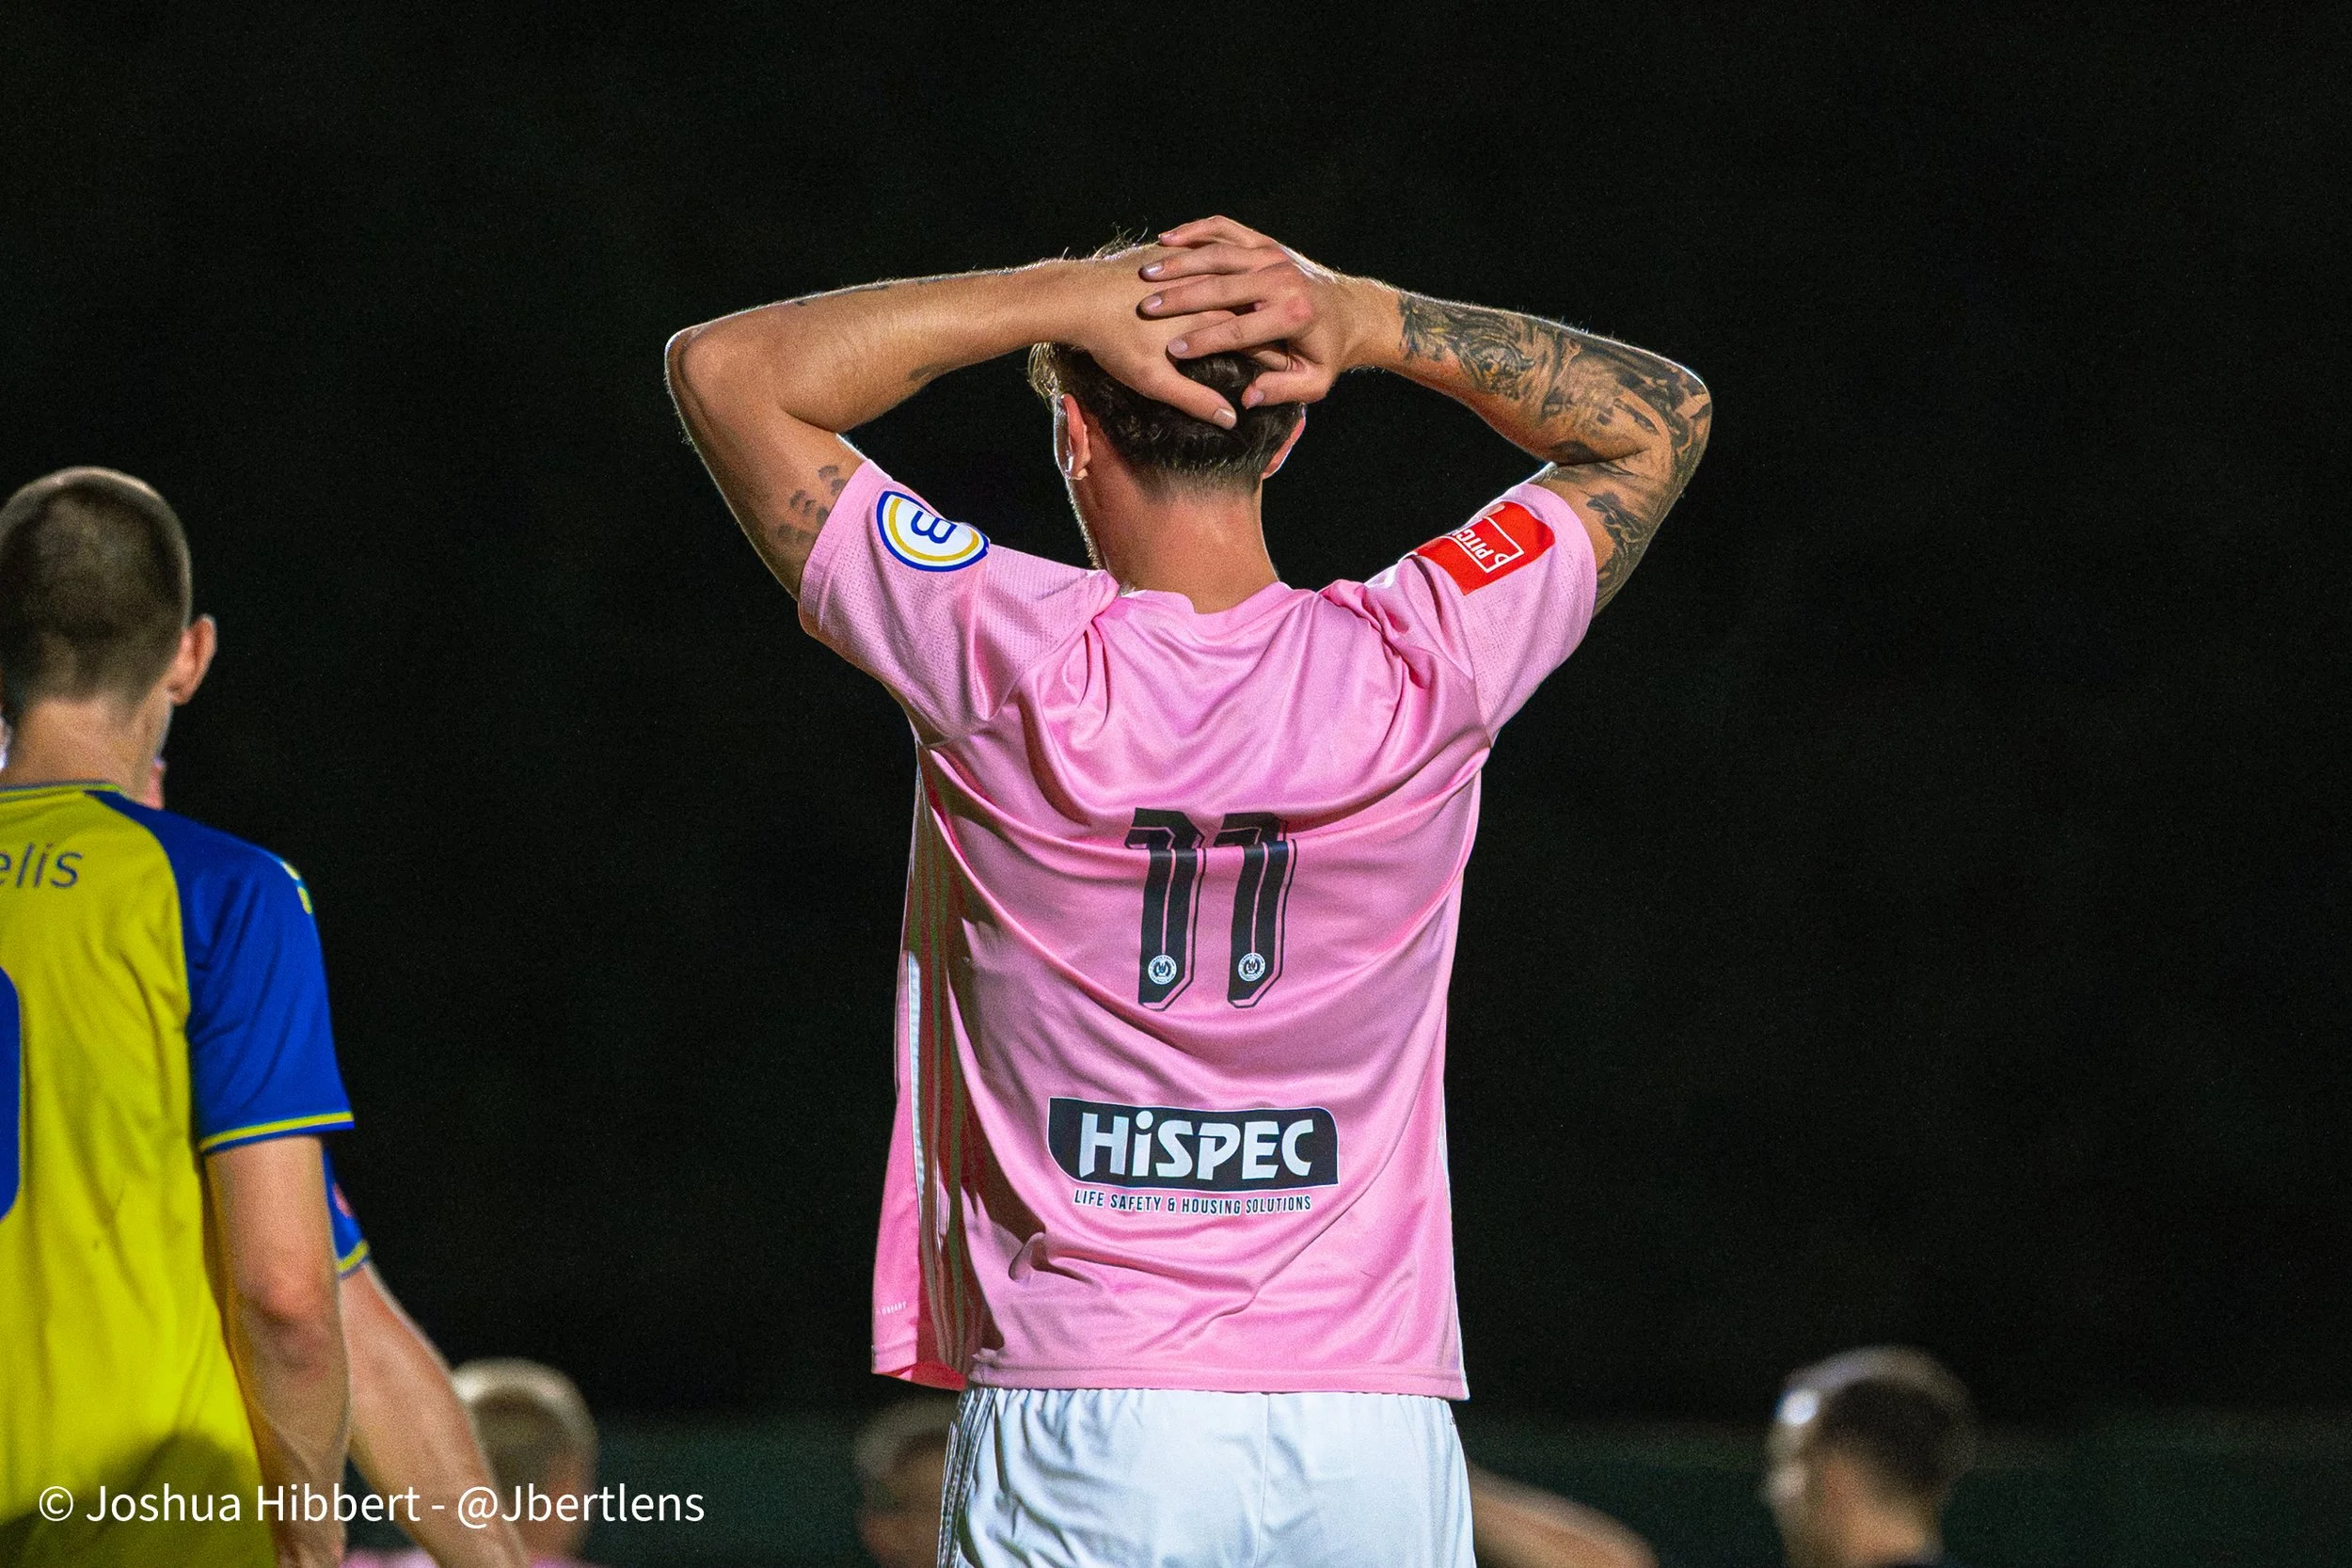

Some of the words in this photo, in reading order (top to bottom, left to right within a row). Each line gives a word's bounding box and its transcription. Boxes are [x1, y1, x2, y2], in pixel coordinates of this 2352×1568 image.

[1454, 528, 1495, 560] PITC
[1124, 807, 1297, 1011] 11
[1079, 1110, 1314, 1180] HiSPEC
[1073, 1189, 1105, 1207] LIFE
[1110, 1194, 1162, 1212] SAFETY
[1168, 1197, 1176, 1212] &
[1182, 1197, 1242, 1214] HOUSING
[1246, 1196, 1311, 1213] SOLUTIONS
